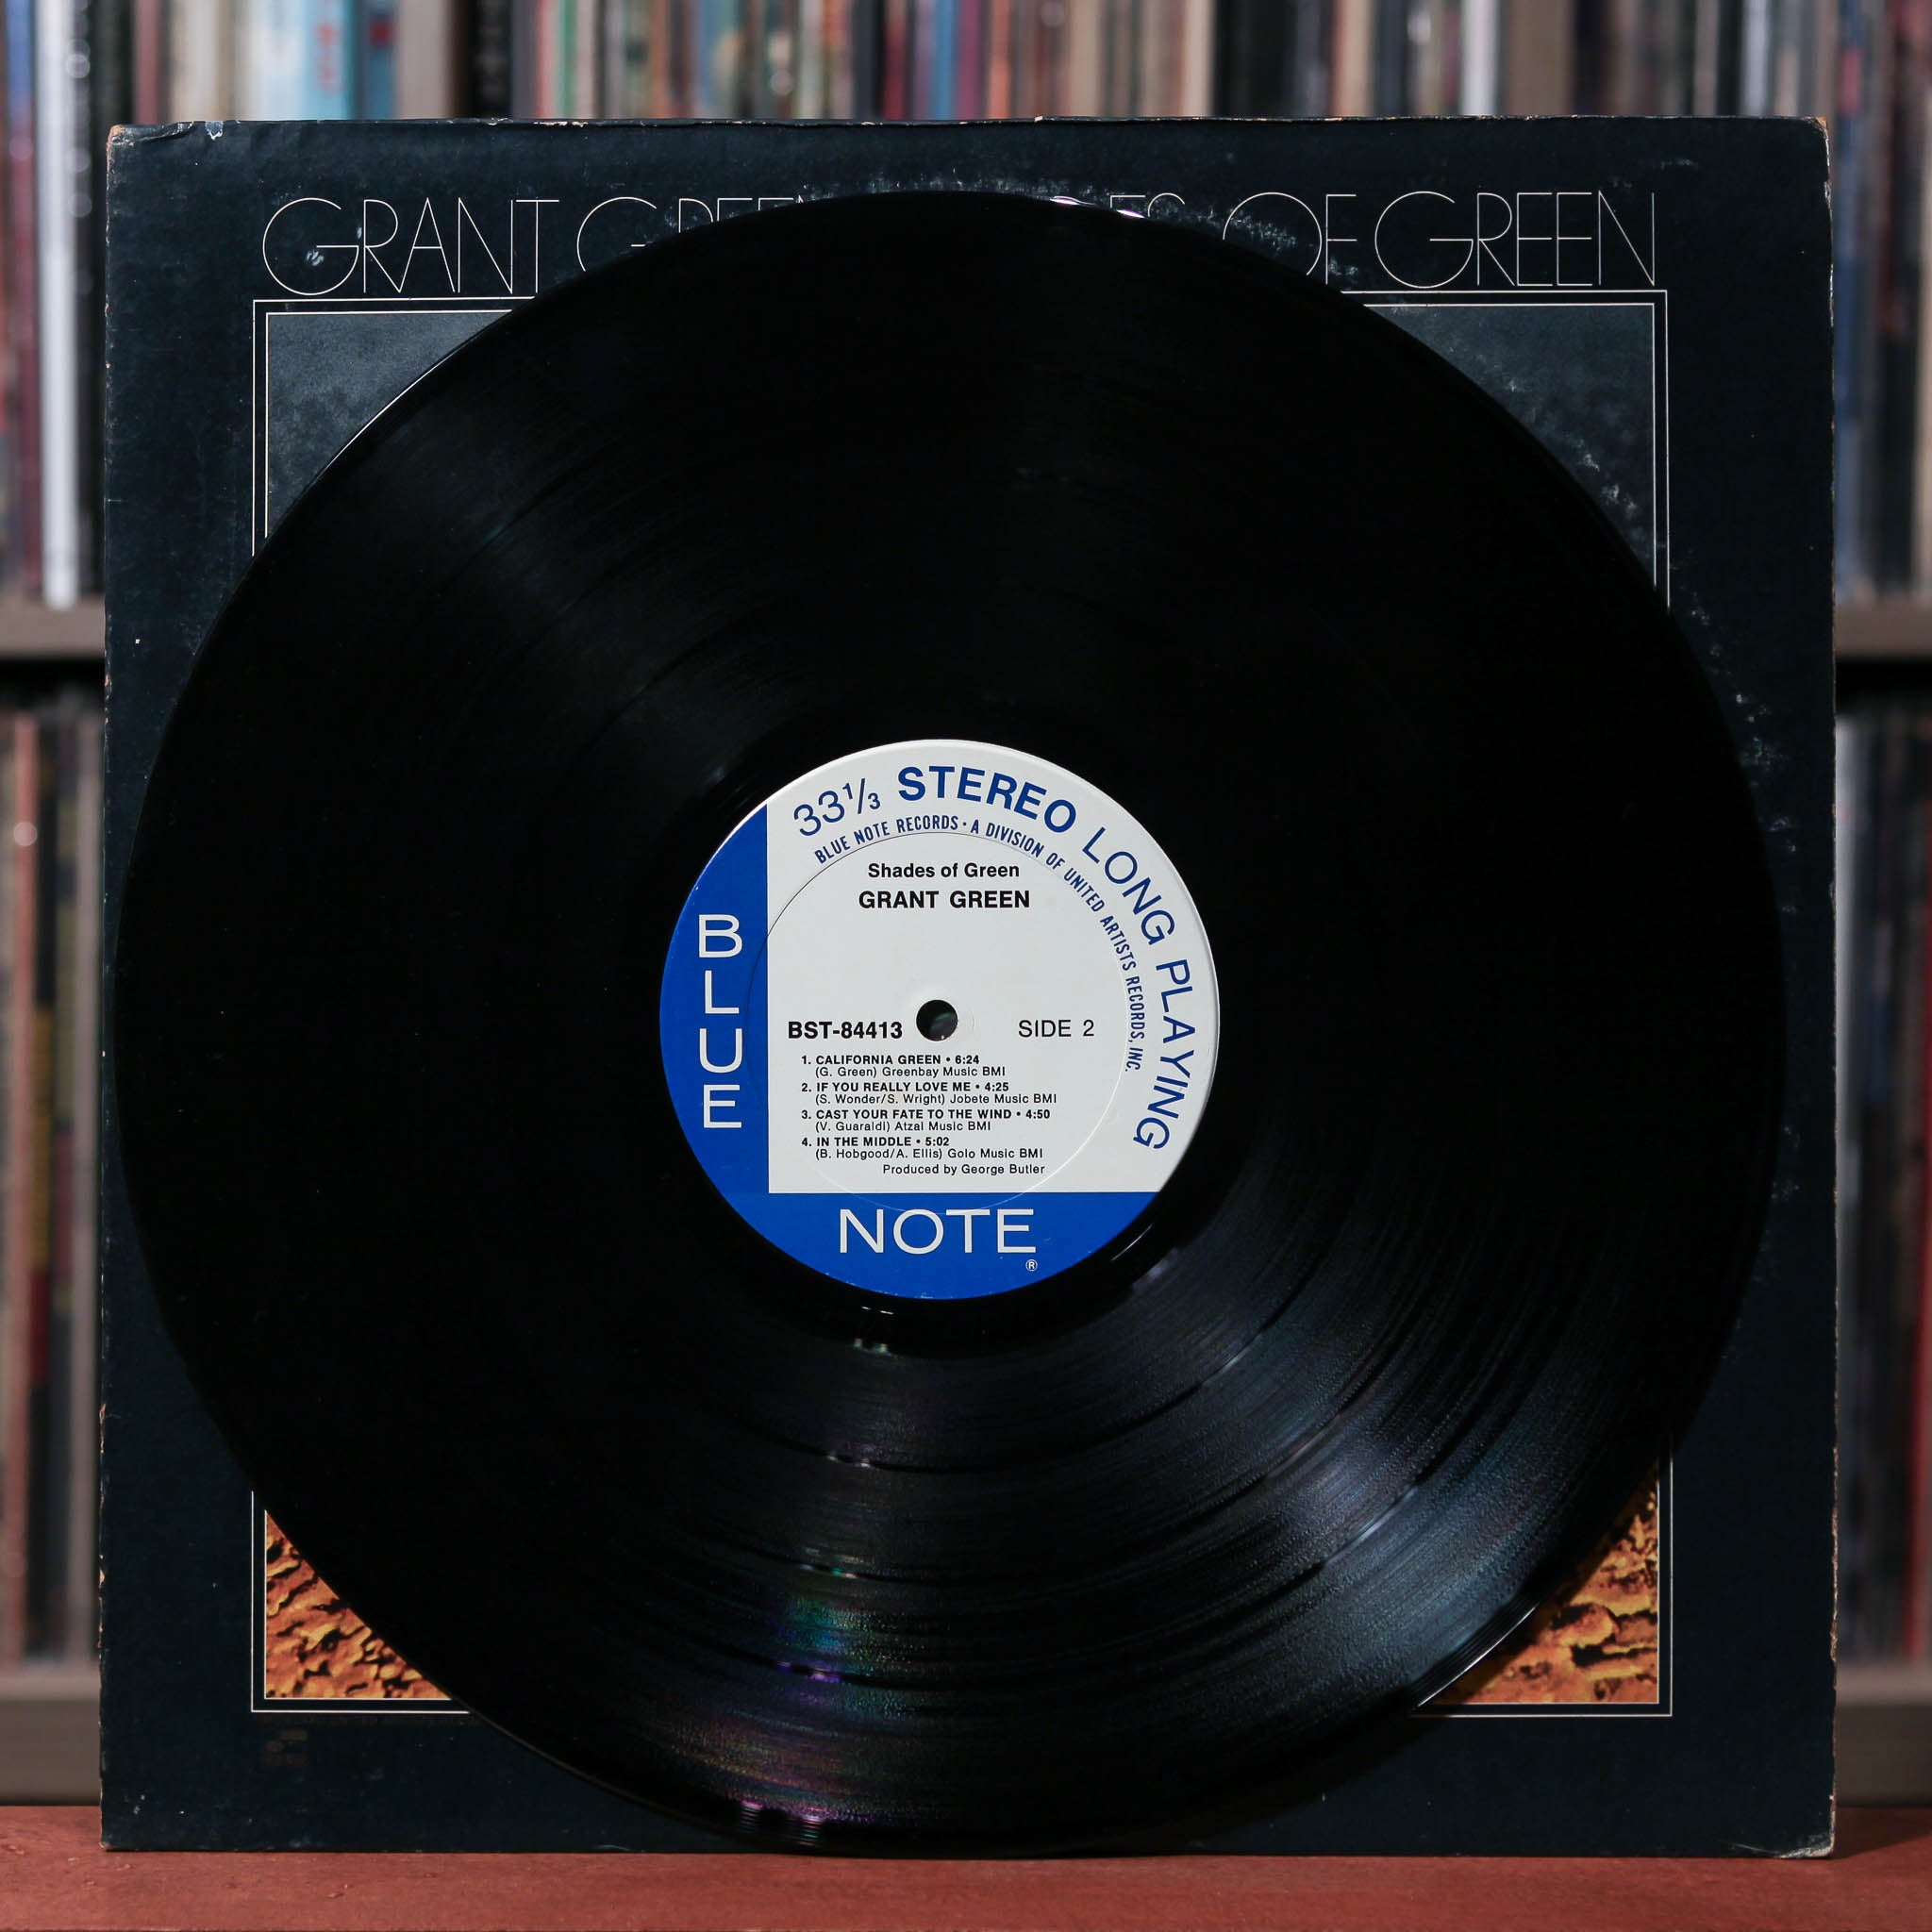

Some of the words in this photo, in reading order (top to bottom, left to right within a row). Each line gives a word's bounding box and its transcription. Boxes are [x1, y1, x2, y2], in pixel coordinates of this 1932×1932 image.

[262, 196, 559, 295] GRANT
[1374, 190, 1656, 289] GREEN
[853, 822, 891, 845] NOTE
[970, 819, 980, 834] A
[985, 822, 1045, 858] DIVISION
[814, 835, 851, 864] BLUE
[869, 863, 935, 877] Shades
[941, 863, 958, 877] of
[964, 862, 1019, 877] Green
[1045, 852, 1066, 870] OF
[1063, 867, 1106, 913] UNITED
[859, 891, 939, 908] GRANT
[950, 891, 1029, 908] GREEN
[1099, 914, 1138, 973] ARTISTS
[898, 765, 1076, 833] STEREO
[1082, 827, 1175, 945] LONG
[1133, 958, 1196, 1150] PLAYING
[1124, 975, 1145, 1042] RECORDS,
[699, 915, 741, 1127] BLUE
[789, 1022, 902, 1039] BST-84413
[1019, 1020, 1071, 1038] SIDE
[1083, 1020, 1094, 1036] 2
[802, 1056, 810, 1064] 1.
[816, 1055, 892, 1064] CALIFORNIA
[898, 1055, 941, 1064] GREEN
[956, 1055, 979, 1064] 6:24
[1124, 1046, 1144, 1073] INC.
[816, 1067, 832, 1078] (G.
[838, 1067, 876, 1078] Green)
[882, 1067, 939, 1078] Greenbay
[943, 1067, 977, 1076] Music
[983, 1066, 1005, 1075] BMI
[802, 1083, 811, 1091] 2.
[817, 1083, 828, 1091] IF
[832, 1082, 858, 1091] YOU
[864, 1082, 910, 1091] REALLY
[916, 1082, 947, 1091] LOVE
[953, 1082, 971, 1091] ME
[985, 1082, 1008, 1091] 4:25
[816, 1094, 830, 1106] (S.
[835, 1094, 898, 1104] Wonder/S.
[903, 1093, 944, 1106] Wright)
[950, 1094, 989, 1104] Jobete
[995, 1094, 1028, 1103] Music
[1034, 1093, 1056, 1103] BMI
[802, 1109, 811, 1119] 3.
[816, 1109, 848, 1119] CAST
[853, 1109, 888, 1119] YOUR
[893, 1109, 923, 1119] FATE
[927, 1109, 943, 1119] TO
[948, 1109, 972, 1119] THE
[977, 1109, 1011, 1119] WIND
[1025, 1109, 1050, 1119] 4:50
[816, 1122, 830, 1133] (V.
[836, 1122, 890, 1132] Guaraldi)
[895, 1122, 924, 1130] Atzal
[929, 1122, 963, 1130] Music
[968, 1122, 991, 1130] BMI
[802, 1138, 811, 1146] 4.
[817, 1137, 829, 1146] IN
[834, 1137, 858, 1146] THE
[863, 1137, 911, 1146] MIDDLE
[925, 1137, 949, 1146] 5:02
[816, 1149, 831, 1160] (B.
[837, 1149, 908, 1160] Hobgood/A.
[913, 1148, 941, 1159] Ellis)
[948, 1148, 975, 1158] Golo
[981, 1148, 1014, 1158] Music
[1020, 1148, 1042, 1158] BMI
[883, 1164, 939, 1174] Produced
[944, 1164, 957, 1175] by
[961, 1164, 1004, 1175] George
[1009, 1164, 1044, 1174] Butler
[841, 1209, 1035, 1254] NOTE
